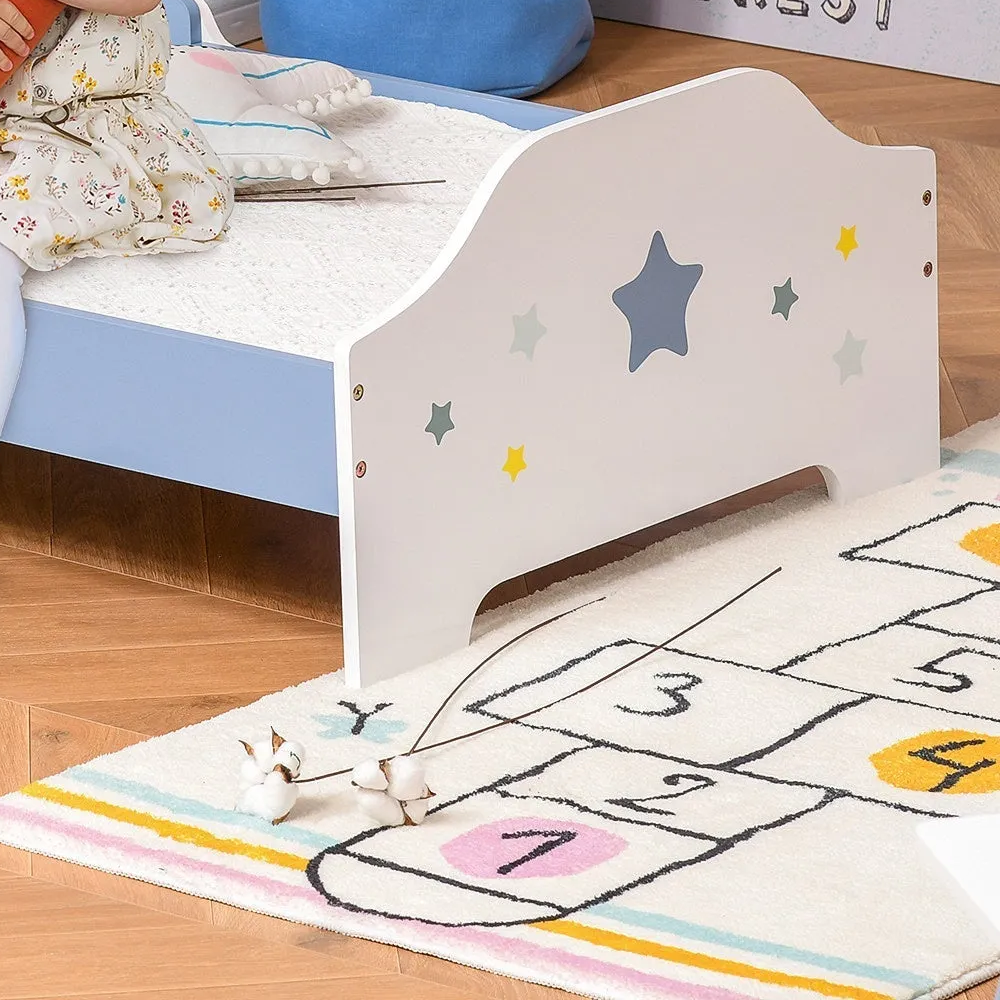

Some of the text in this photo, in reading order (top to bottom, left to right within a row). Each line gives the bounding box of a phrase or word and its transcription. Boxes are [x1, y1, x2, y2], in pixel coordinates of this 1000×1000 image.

[894, 646, 1000, 693] 5
[614, 672, 702, 717] 3
[908, 738, 997, 793] 4
[604, 772, 717, 816] 2
